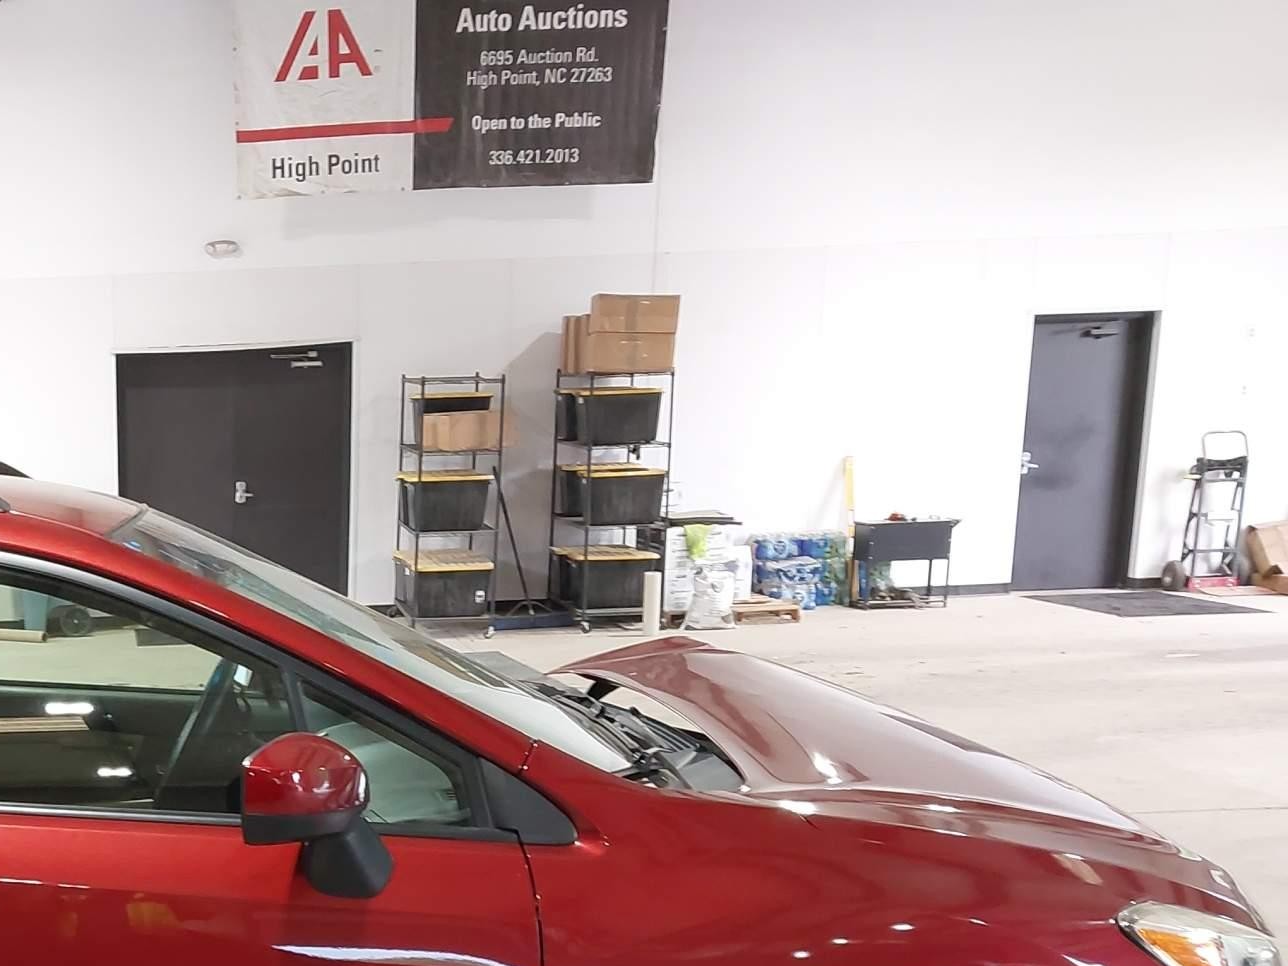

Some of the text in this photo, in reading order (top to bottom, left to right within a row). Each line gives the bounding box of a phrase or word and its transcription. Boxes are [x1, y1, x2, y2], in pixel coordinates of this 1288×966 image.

[456, 4, 628, 33] Auto Auctions
[480, 47, 599, 66] 6695 Auction Rd.
[466, 67, 613, 89] High Point, NC 27263
[471, 112, 602, 134] Open to the Public
[272, 153, 380, 182] High Point
[488, 148, 580, 165] 336.421.2013
